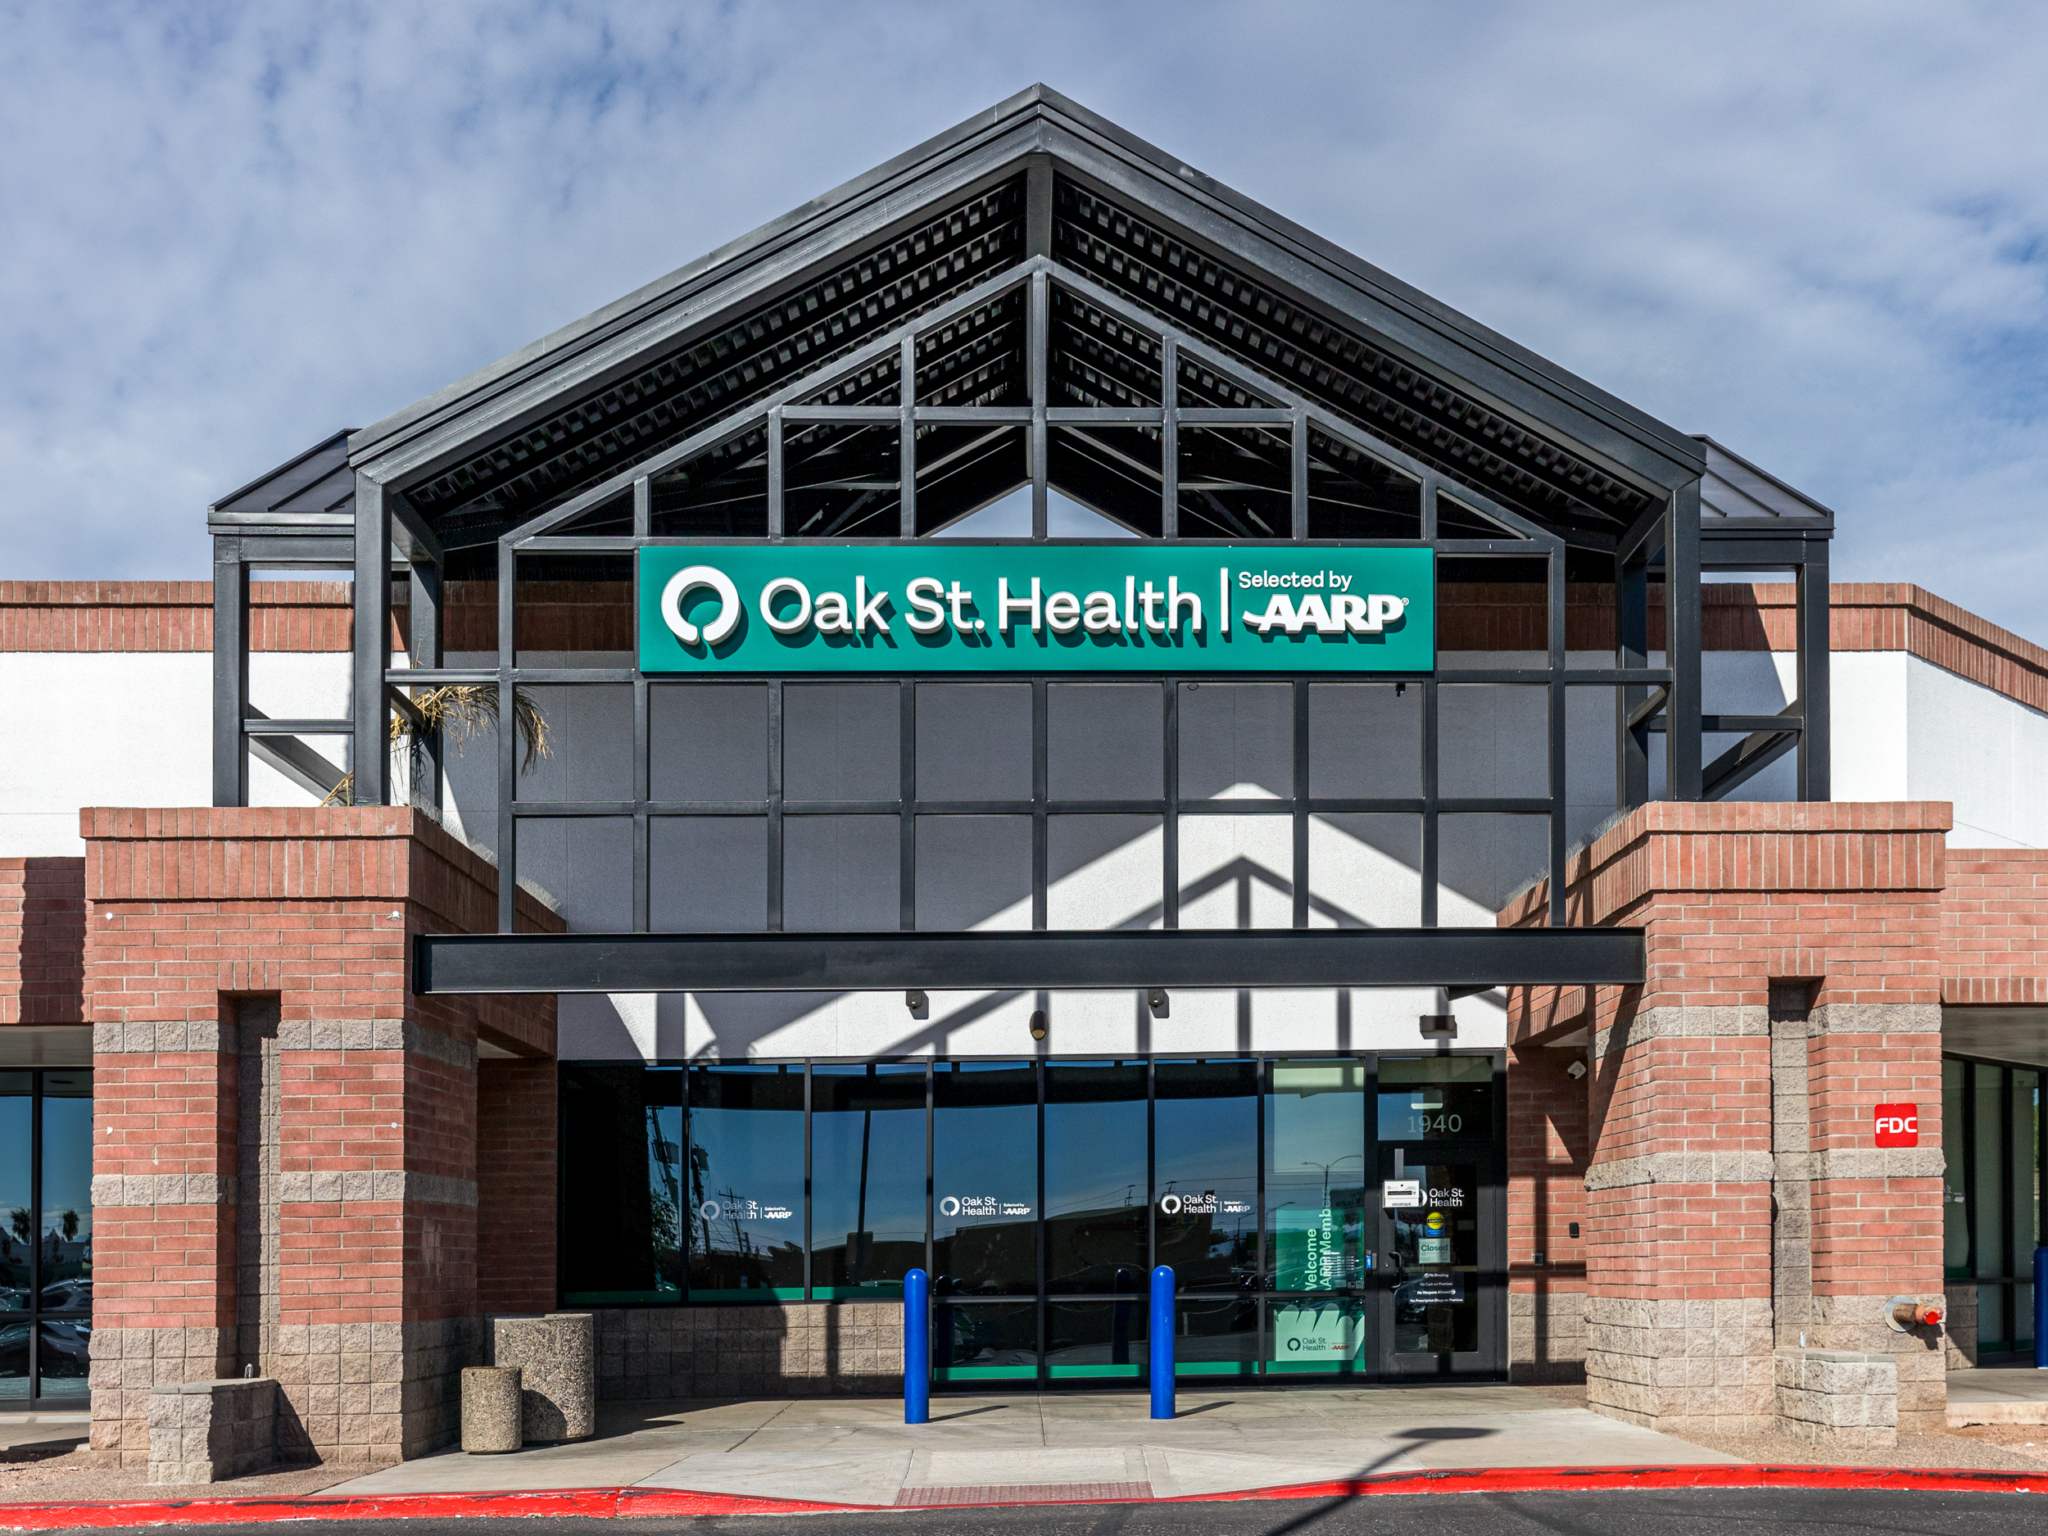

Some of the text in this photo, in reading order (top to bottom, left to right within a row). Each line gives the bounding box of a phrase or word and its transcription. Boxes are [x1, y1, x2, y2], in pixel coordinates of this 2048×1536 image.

[1238, 570, 1353, 592] Selected by
[760, 575, 1202, 635] Oak St. Health
[1407, 1114, 1462, 1133] 1940
[1875, 1116, 1918, 1134] FDC
[1429, 1187, 1465, 1198] Oak St.
[961, 1196, 998, 1206] Oak St.
[1182, 1194, 1219, 1204] Oak St.
[1430, 1197, 1463, 1208] Health
[722, 1200, 759, 1210] Oak St.
[962, 1205, 996, 1216] Health
[1183, 1203, 1217, 1214] Health
[1223, 1205, 1251, 1213] AARP
[723, 1209, 757, 1220] Health
[764, 1211, 792, 1219] AARP
[1003, 1207, 1031, 1215] AARP
[1421, 1244, 1449, 1252] Closed
[1302, 1337, 1327, 1345] Oak St.
